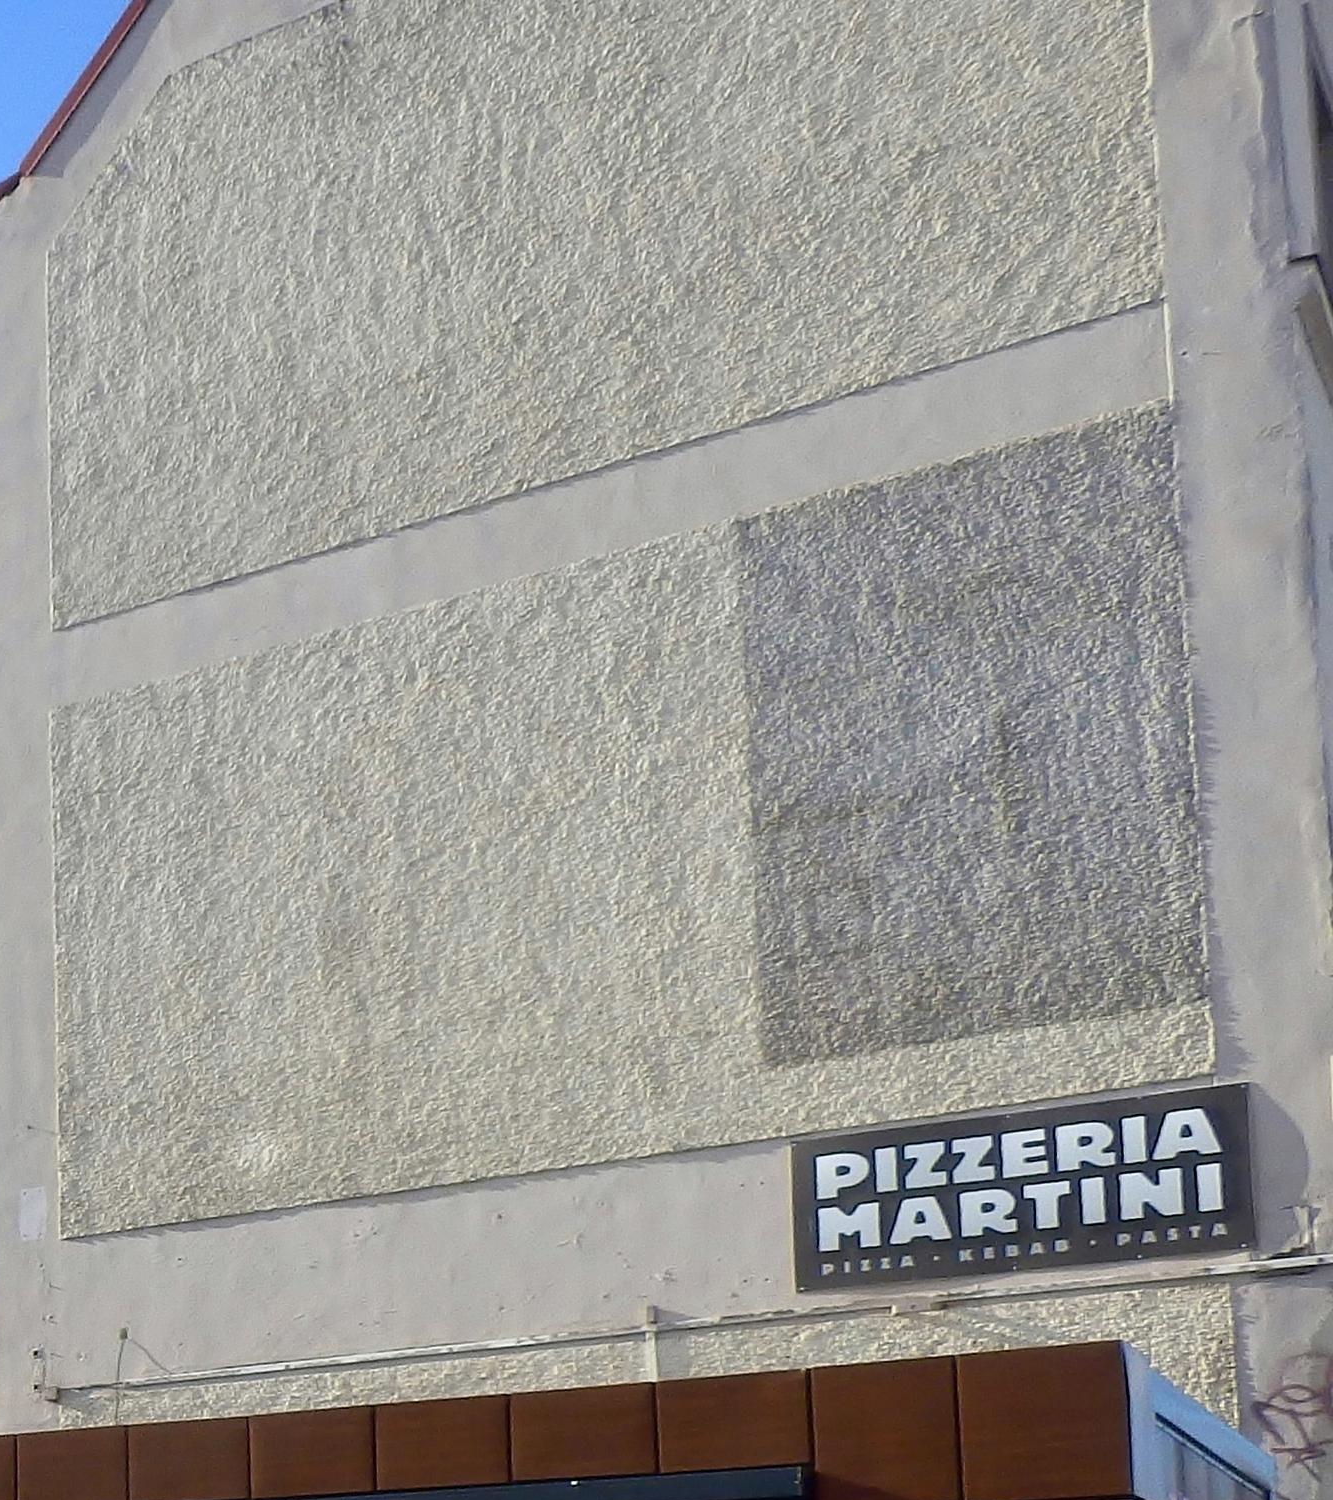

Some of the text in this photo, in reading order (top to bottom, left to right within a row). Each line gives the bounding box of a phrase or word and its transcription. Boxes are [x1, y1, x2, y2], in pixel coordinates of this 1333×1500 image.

[815, 1108, 1222, 1200] PIZZERIA
[817, 1162, 1225, 1253] MARTINI
[820, 1222, 1229, 1277] PIZZA KEBAB PASTA
